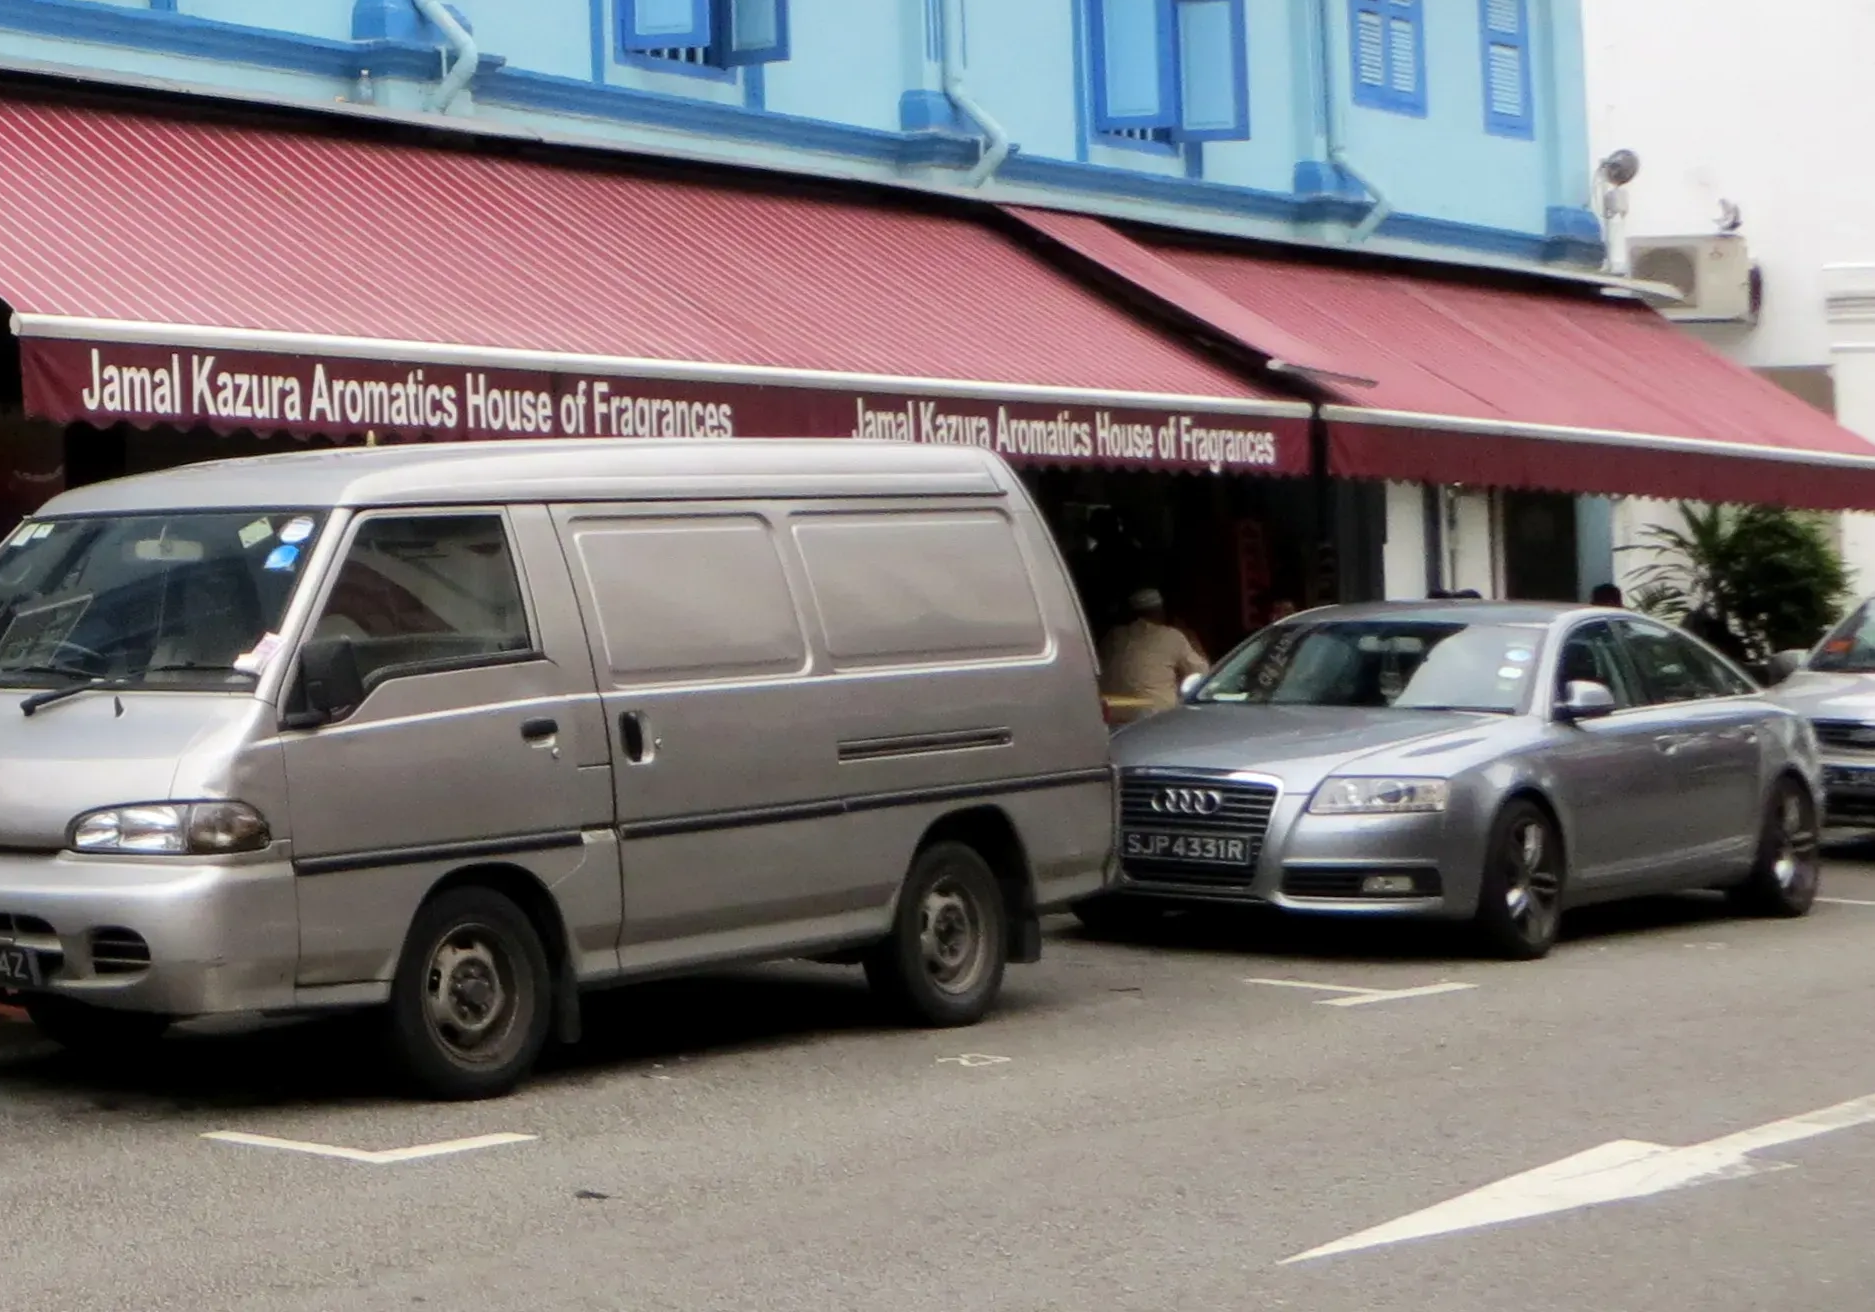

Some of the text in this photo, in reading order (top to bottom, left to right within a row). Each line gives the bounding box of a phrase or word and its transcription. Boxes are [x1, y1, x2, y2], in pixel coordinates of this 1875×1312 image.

[82, 348, 734, 438] Jamal Kazura Aromatics House of Fragrances
[852, 397, 1275, 473] Jamal Kazura Aromatics House of Fragrances
